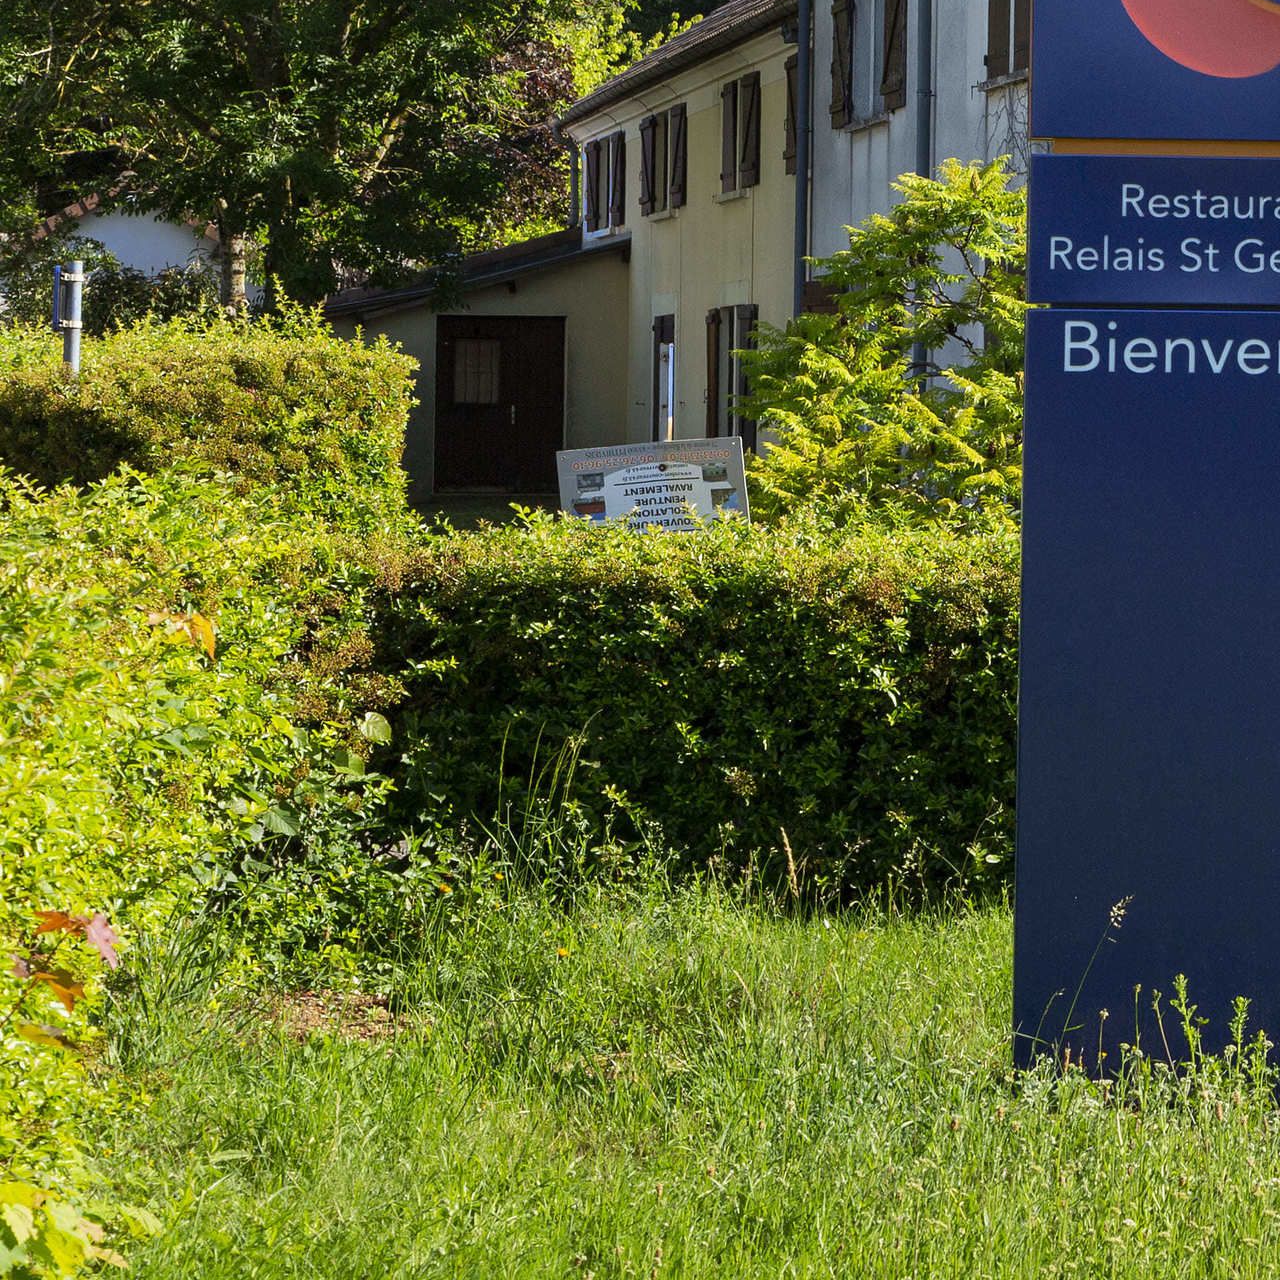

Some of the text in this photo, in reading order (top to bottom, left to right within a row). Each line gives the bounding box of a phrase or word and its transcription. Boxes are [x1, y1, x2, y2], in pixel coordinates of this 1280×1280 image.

[1050, 235, 1165, 272] Relais
[1180, 237, 1220, 273] St
[623, 483, 693, 496] RAVALEMENT
[634, 495, 686, 506] PEINTURE
